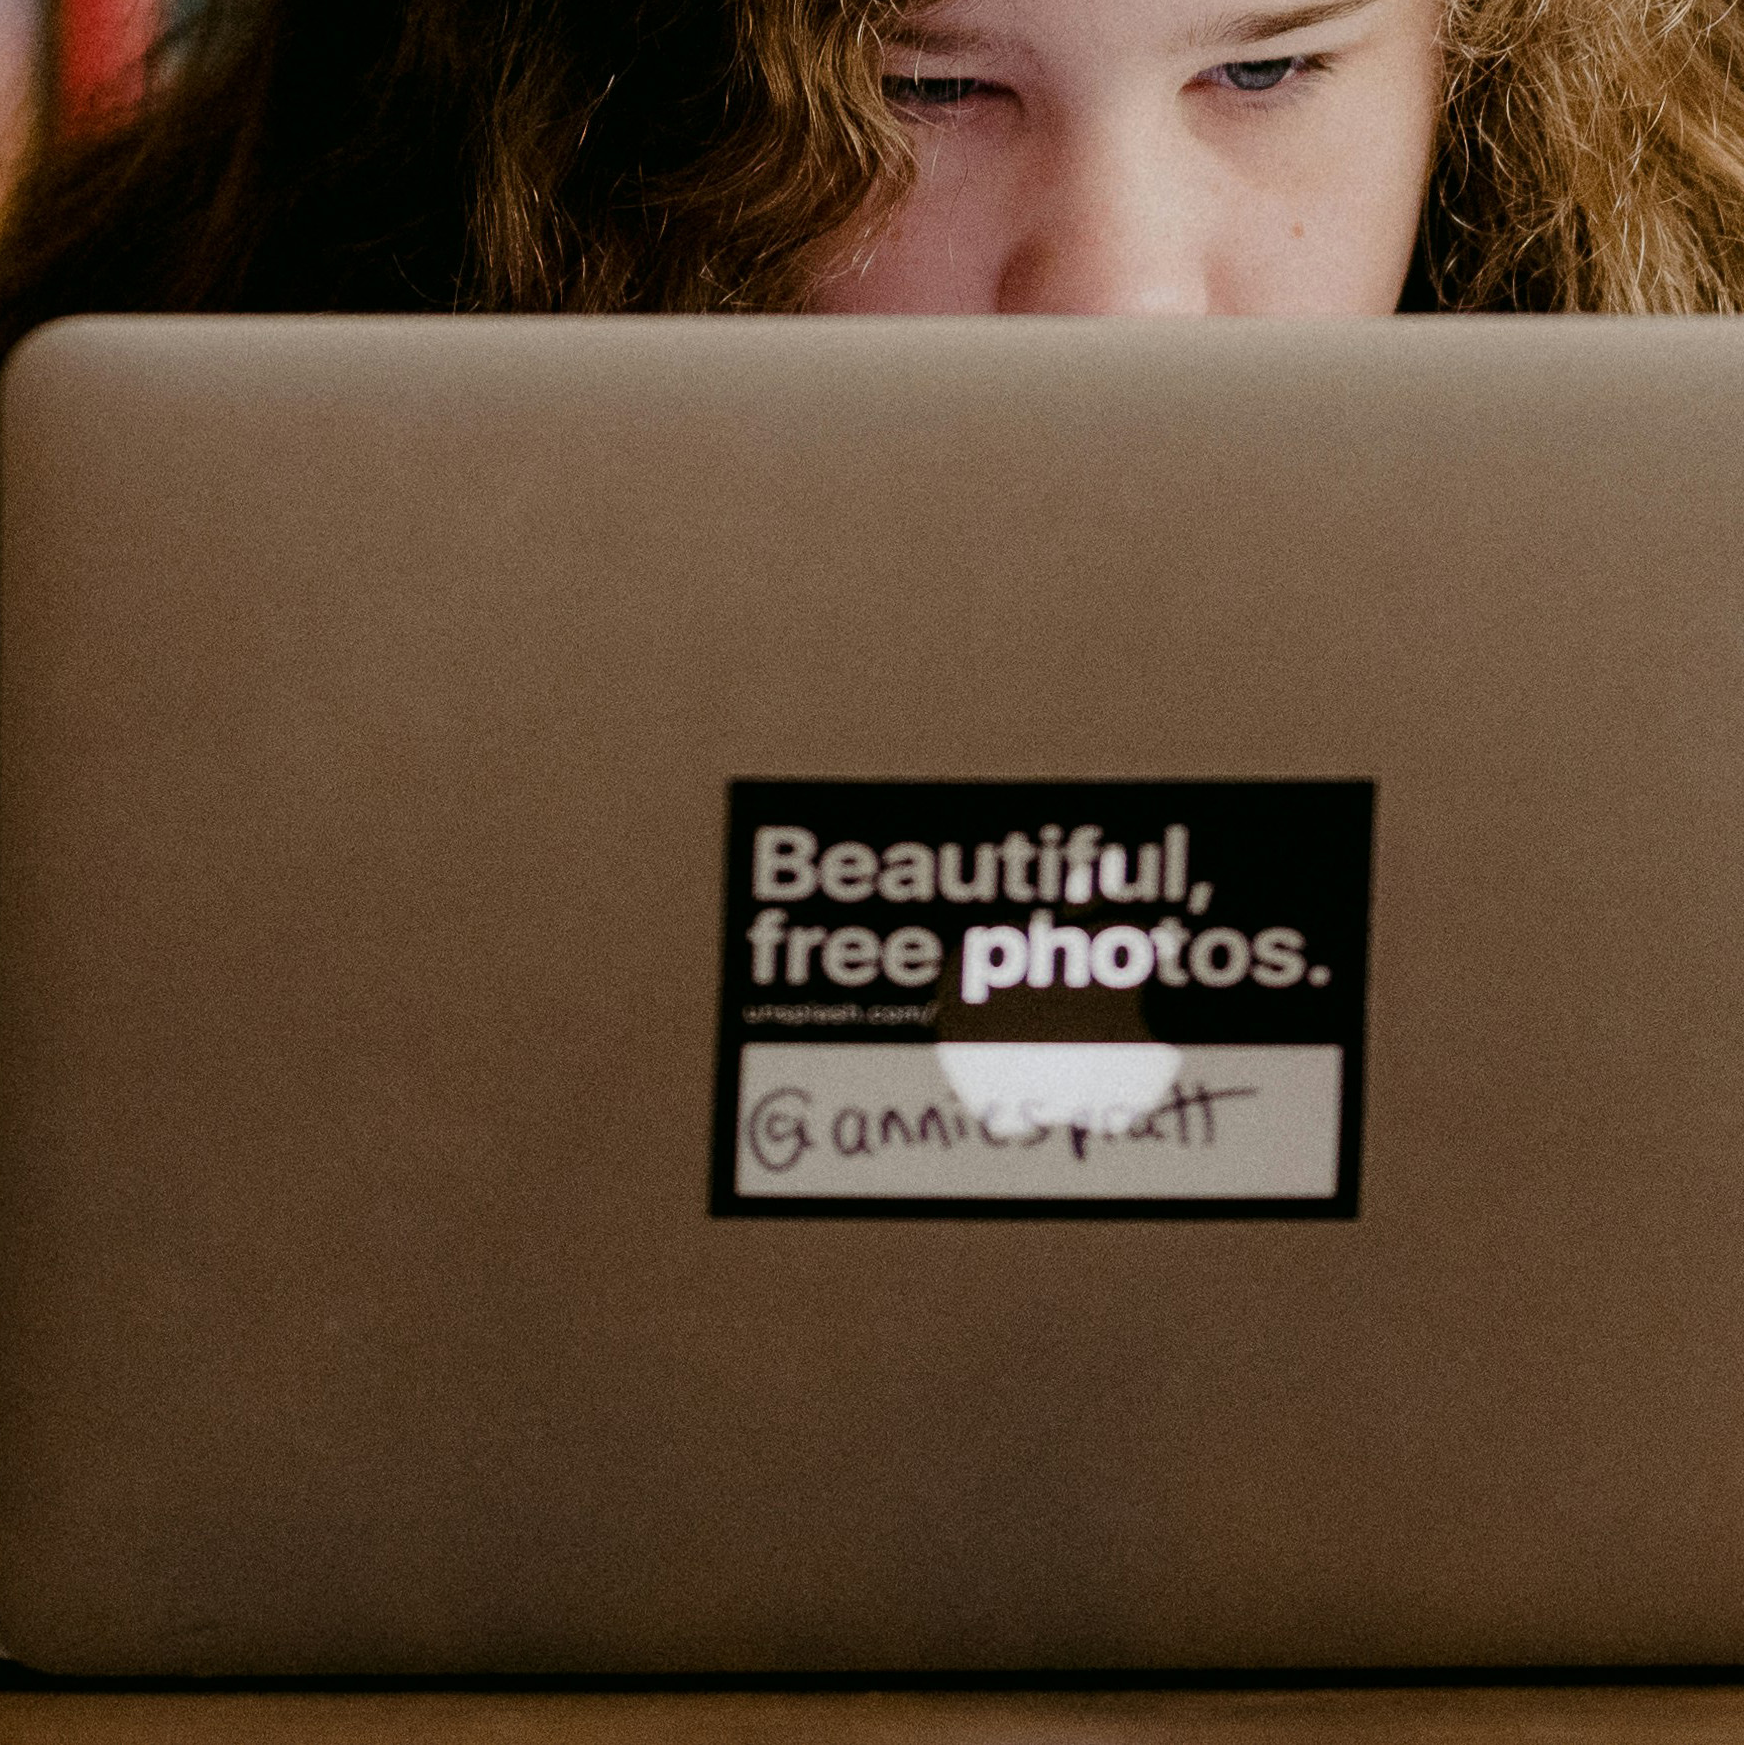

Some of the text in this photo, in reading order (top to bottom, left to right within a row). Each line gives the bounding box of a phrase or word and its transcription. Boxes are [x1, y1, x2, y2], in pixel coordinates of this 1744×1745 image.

[752, 823, 1214, 915] Beautiful,
[746, 908, 1332, 1006] free photos.
